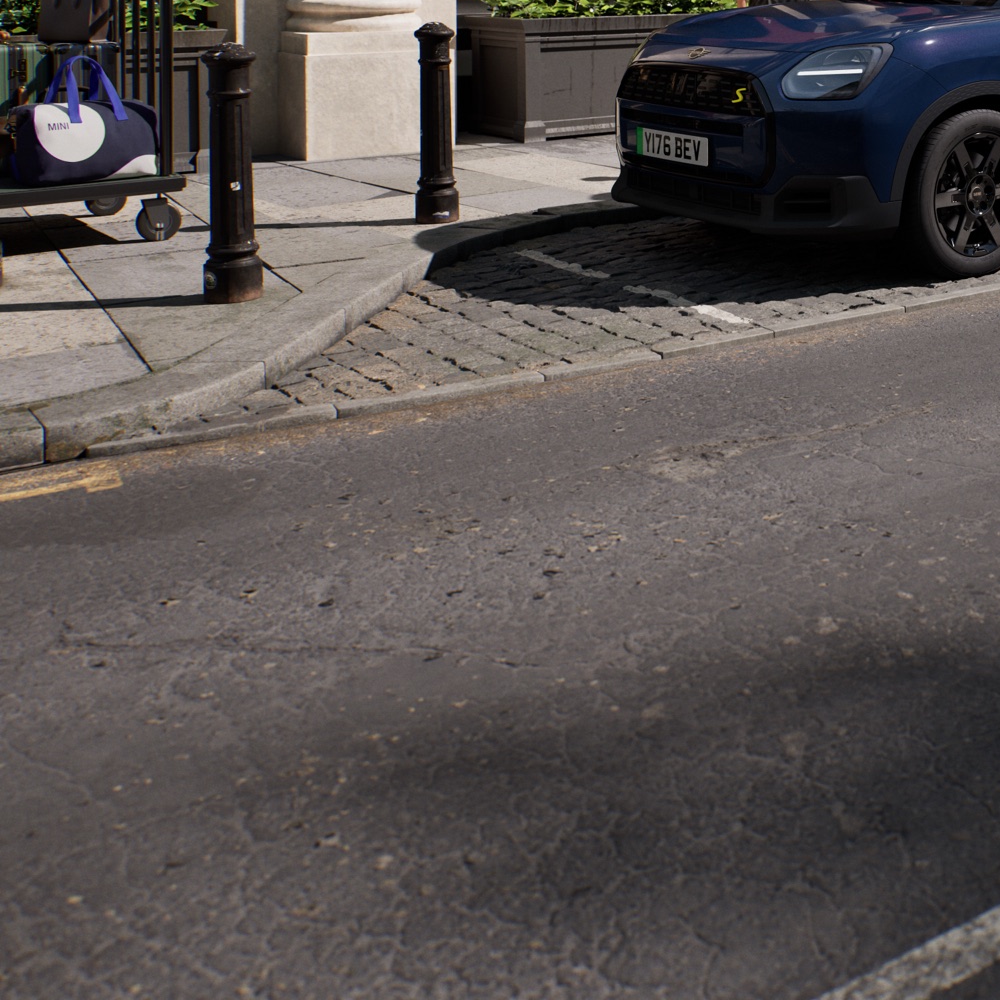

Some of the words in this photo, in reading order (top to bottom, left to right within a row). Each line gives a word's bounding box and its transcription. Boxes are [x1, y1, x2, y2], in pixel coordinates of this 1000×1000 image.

[731, 87, 747, 104] S
[47, 122, 70, 131] MINI
[674, 136, 701, 161] BEV
